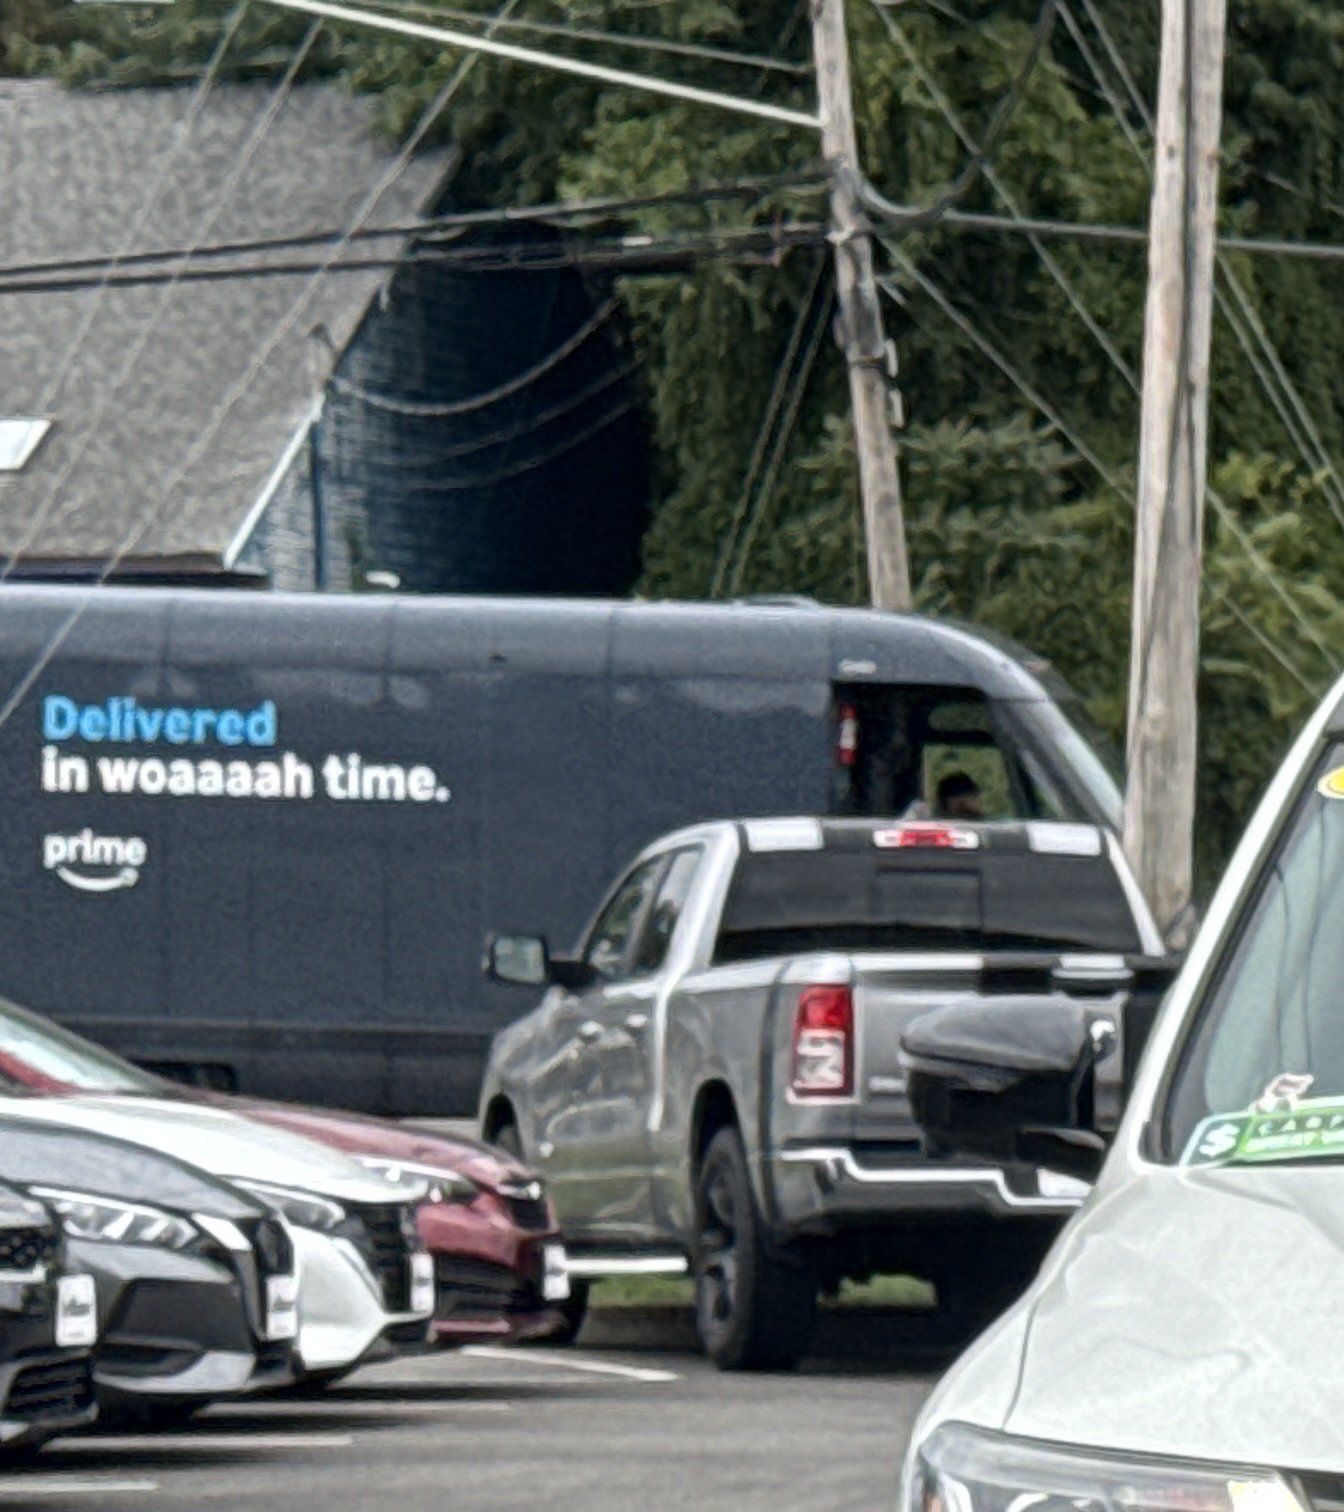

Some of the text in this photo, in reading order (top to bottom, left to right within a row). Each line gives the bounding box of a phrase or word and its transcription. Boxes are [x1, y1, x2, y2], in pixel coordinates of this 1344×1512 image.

[43, 695, 278, 747] Delivered
[41, 745, 452, 802] in woaaaah time.
[43, 828, 148, 869] prime
